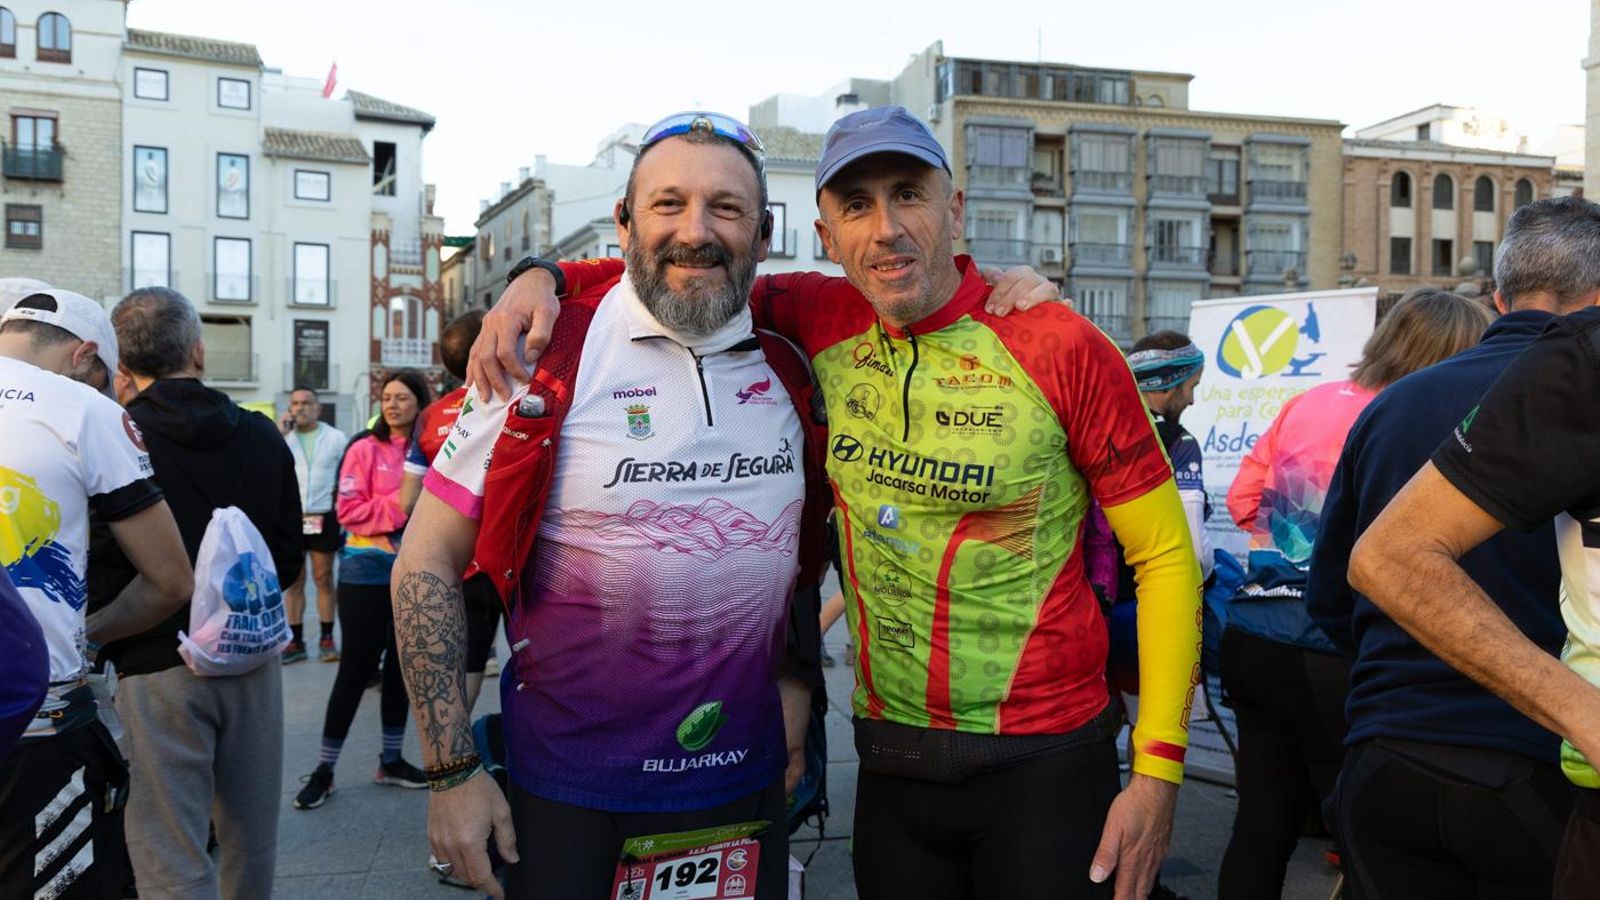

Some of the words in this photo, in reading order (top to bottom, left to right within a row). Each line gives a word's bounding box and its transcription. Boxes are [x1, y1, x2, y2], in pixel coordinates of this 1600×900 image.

[613, 387, 657, 399] mobel
[953, 411, 1003, 428] DUE
[1216, 405, 1252, 421] para
[603, 457, 698, 489] SIERRA
[700, 462, 723, 478] DE
[721, 452, 795, 483] SEGURA
[868, 447, 995, 487] HYUNDAI
[866, 469, 926, 496] Jacarsa
[930, 483, 991, 504] Motor
[642, 749, 749, 773] BUJARKAY
[656, 857, 718, 891] 192
